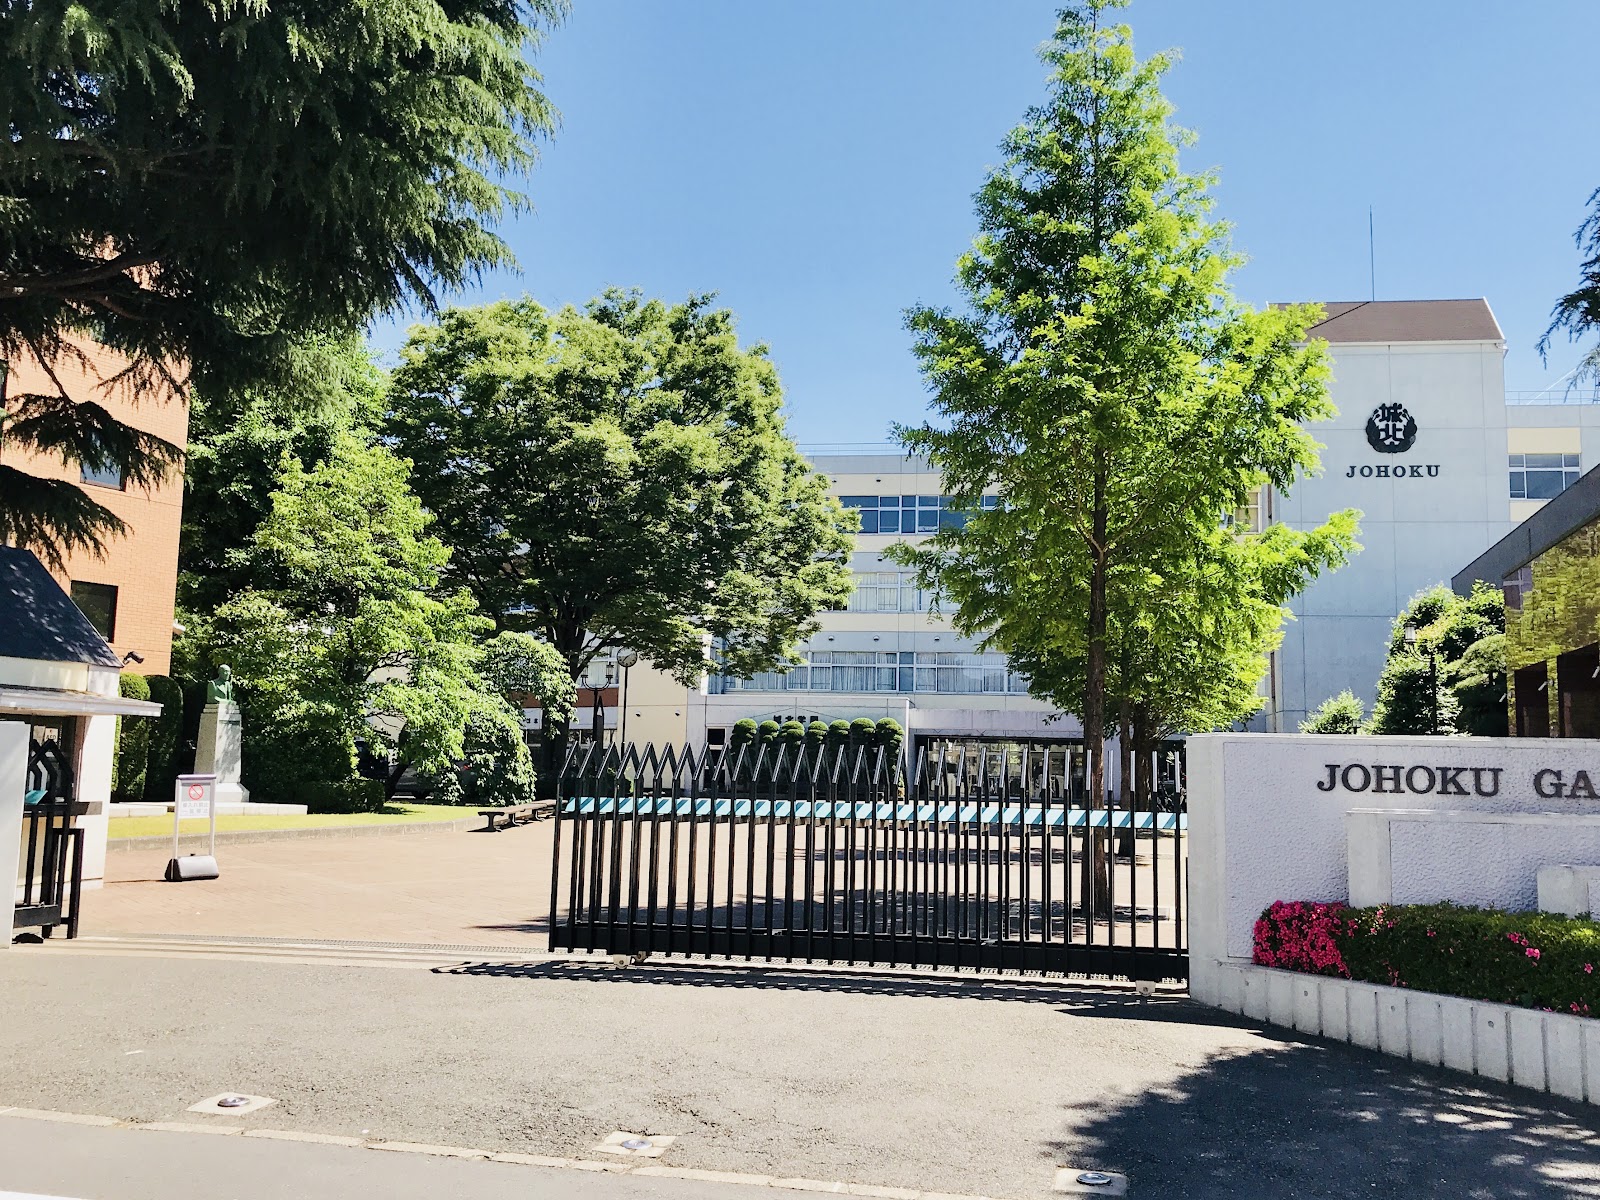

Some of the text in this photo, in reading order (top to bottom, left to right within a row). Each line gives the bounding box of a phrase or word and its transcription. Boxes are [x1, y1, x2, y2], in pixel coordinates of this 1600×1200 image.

[1346, 465, 1440, 478] JOHOKU
[1317, 763, 1600, 799] JOHOKU GA
